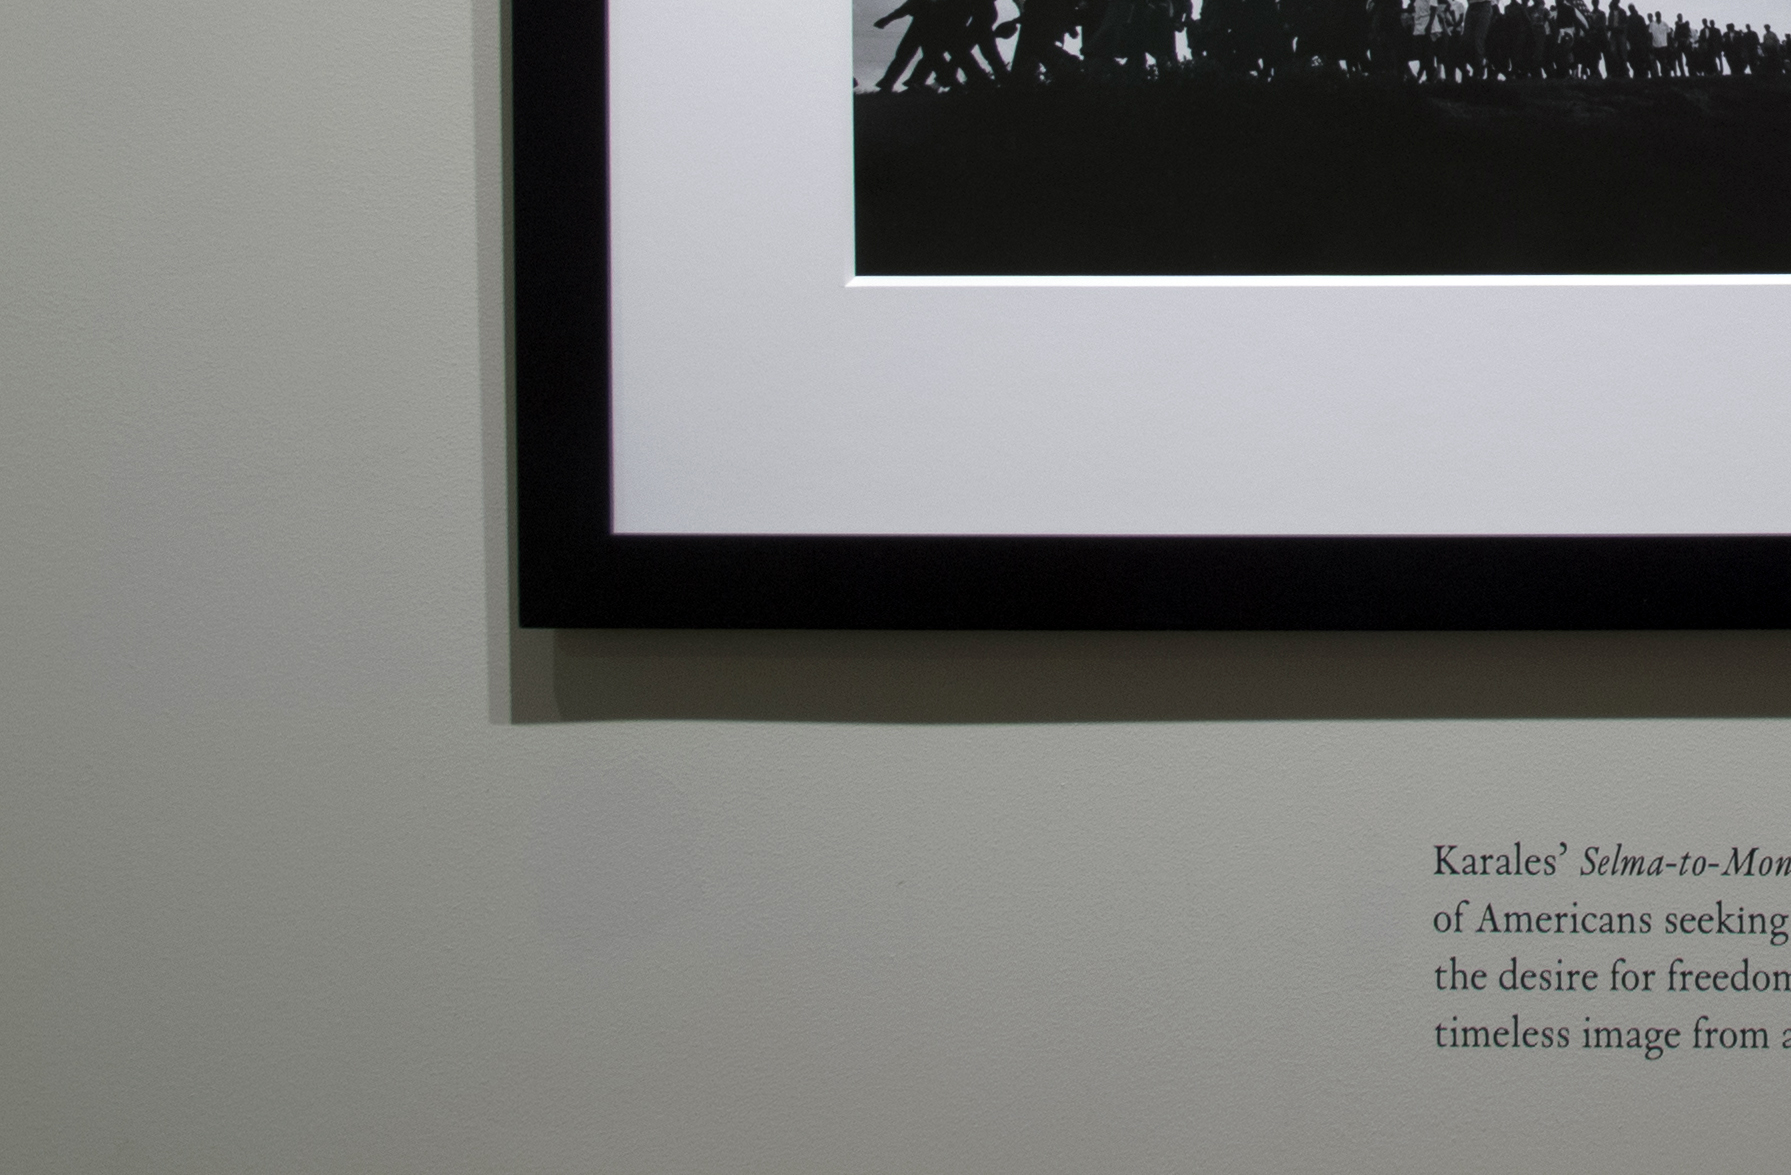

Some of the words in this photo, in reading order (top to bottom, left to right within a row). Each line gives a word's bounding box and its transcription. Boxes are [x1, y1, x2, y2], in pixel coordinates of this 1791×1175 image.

[1433, 840, 1568, 877] Karales’
[1433, 899, 1471, 934] of
[1474, 901, 1652, 935] Americans
[1665, 899, 1790, 947] seeking
[1434, 955, 1488, 991] the
[1498, 956, 1599, 992] desire
[1609, 957, 1657, 992] for
[1434, 1013, 1570, 1049] timeless
[1582, 1016, 1682, 1061] image
[1692, 1014, 1770, 1050] from
